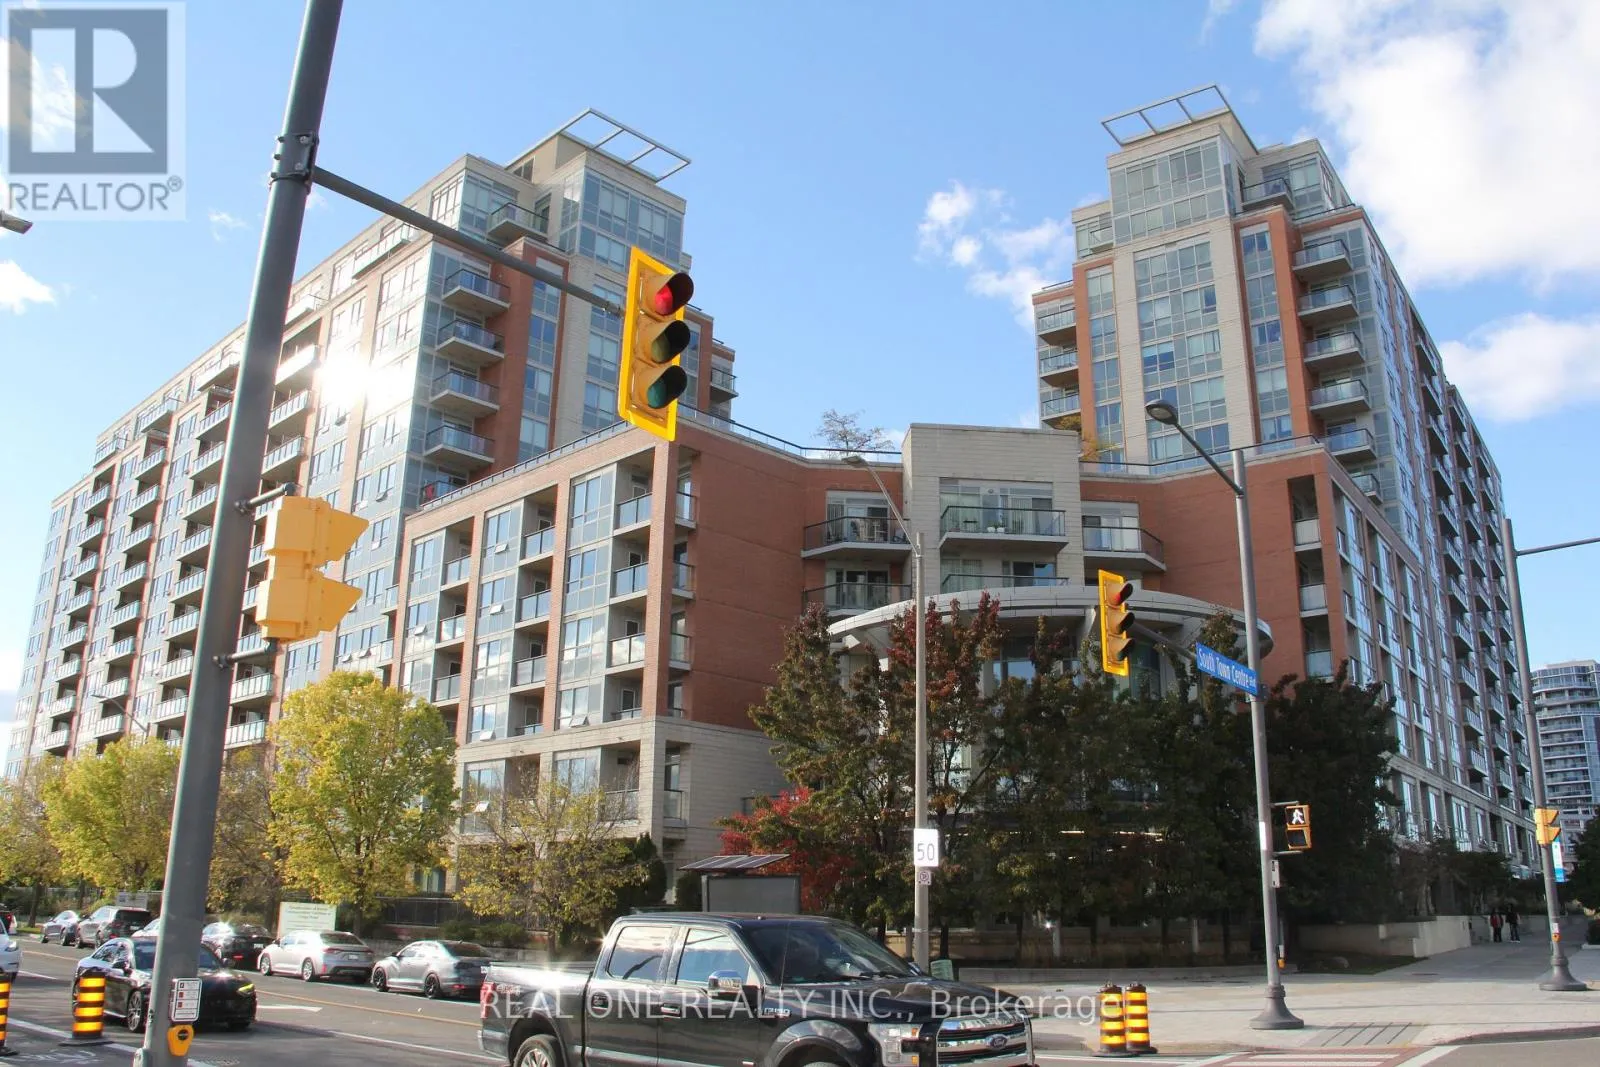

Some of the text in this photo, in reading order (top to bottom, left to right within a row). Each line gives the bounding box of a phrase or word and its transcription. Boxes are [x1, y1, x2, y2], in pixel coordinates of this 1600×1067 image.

[1198, 648, 1216, 673] South
[1216, 657, 1231, 681] Town
[1231, 665, 1249, 688] Centre
[917, 843, 935, 861] 50
